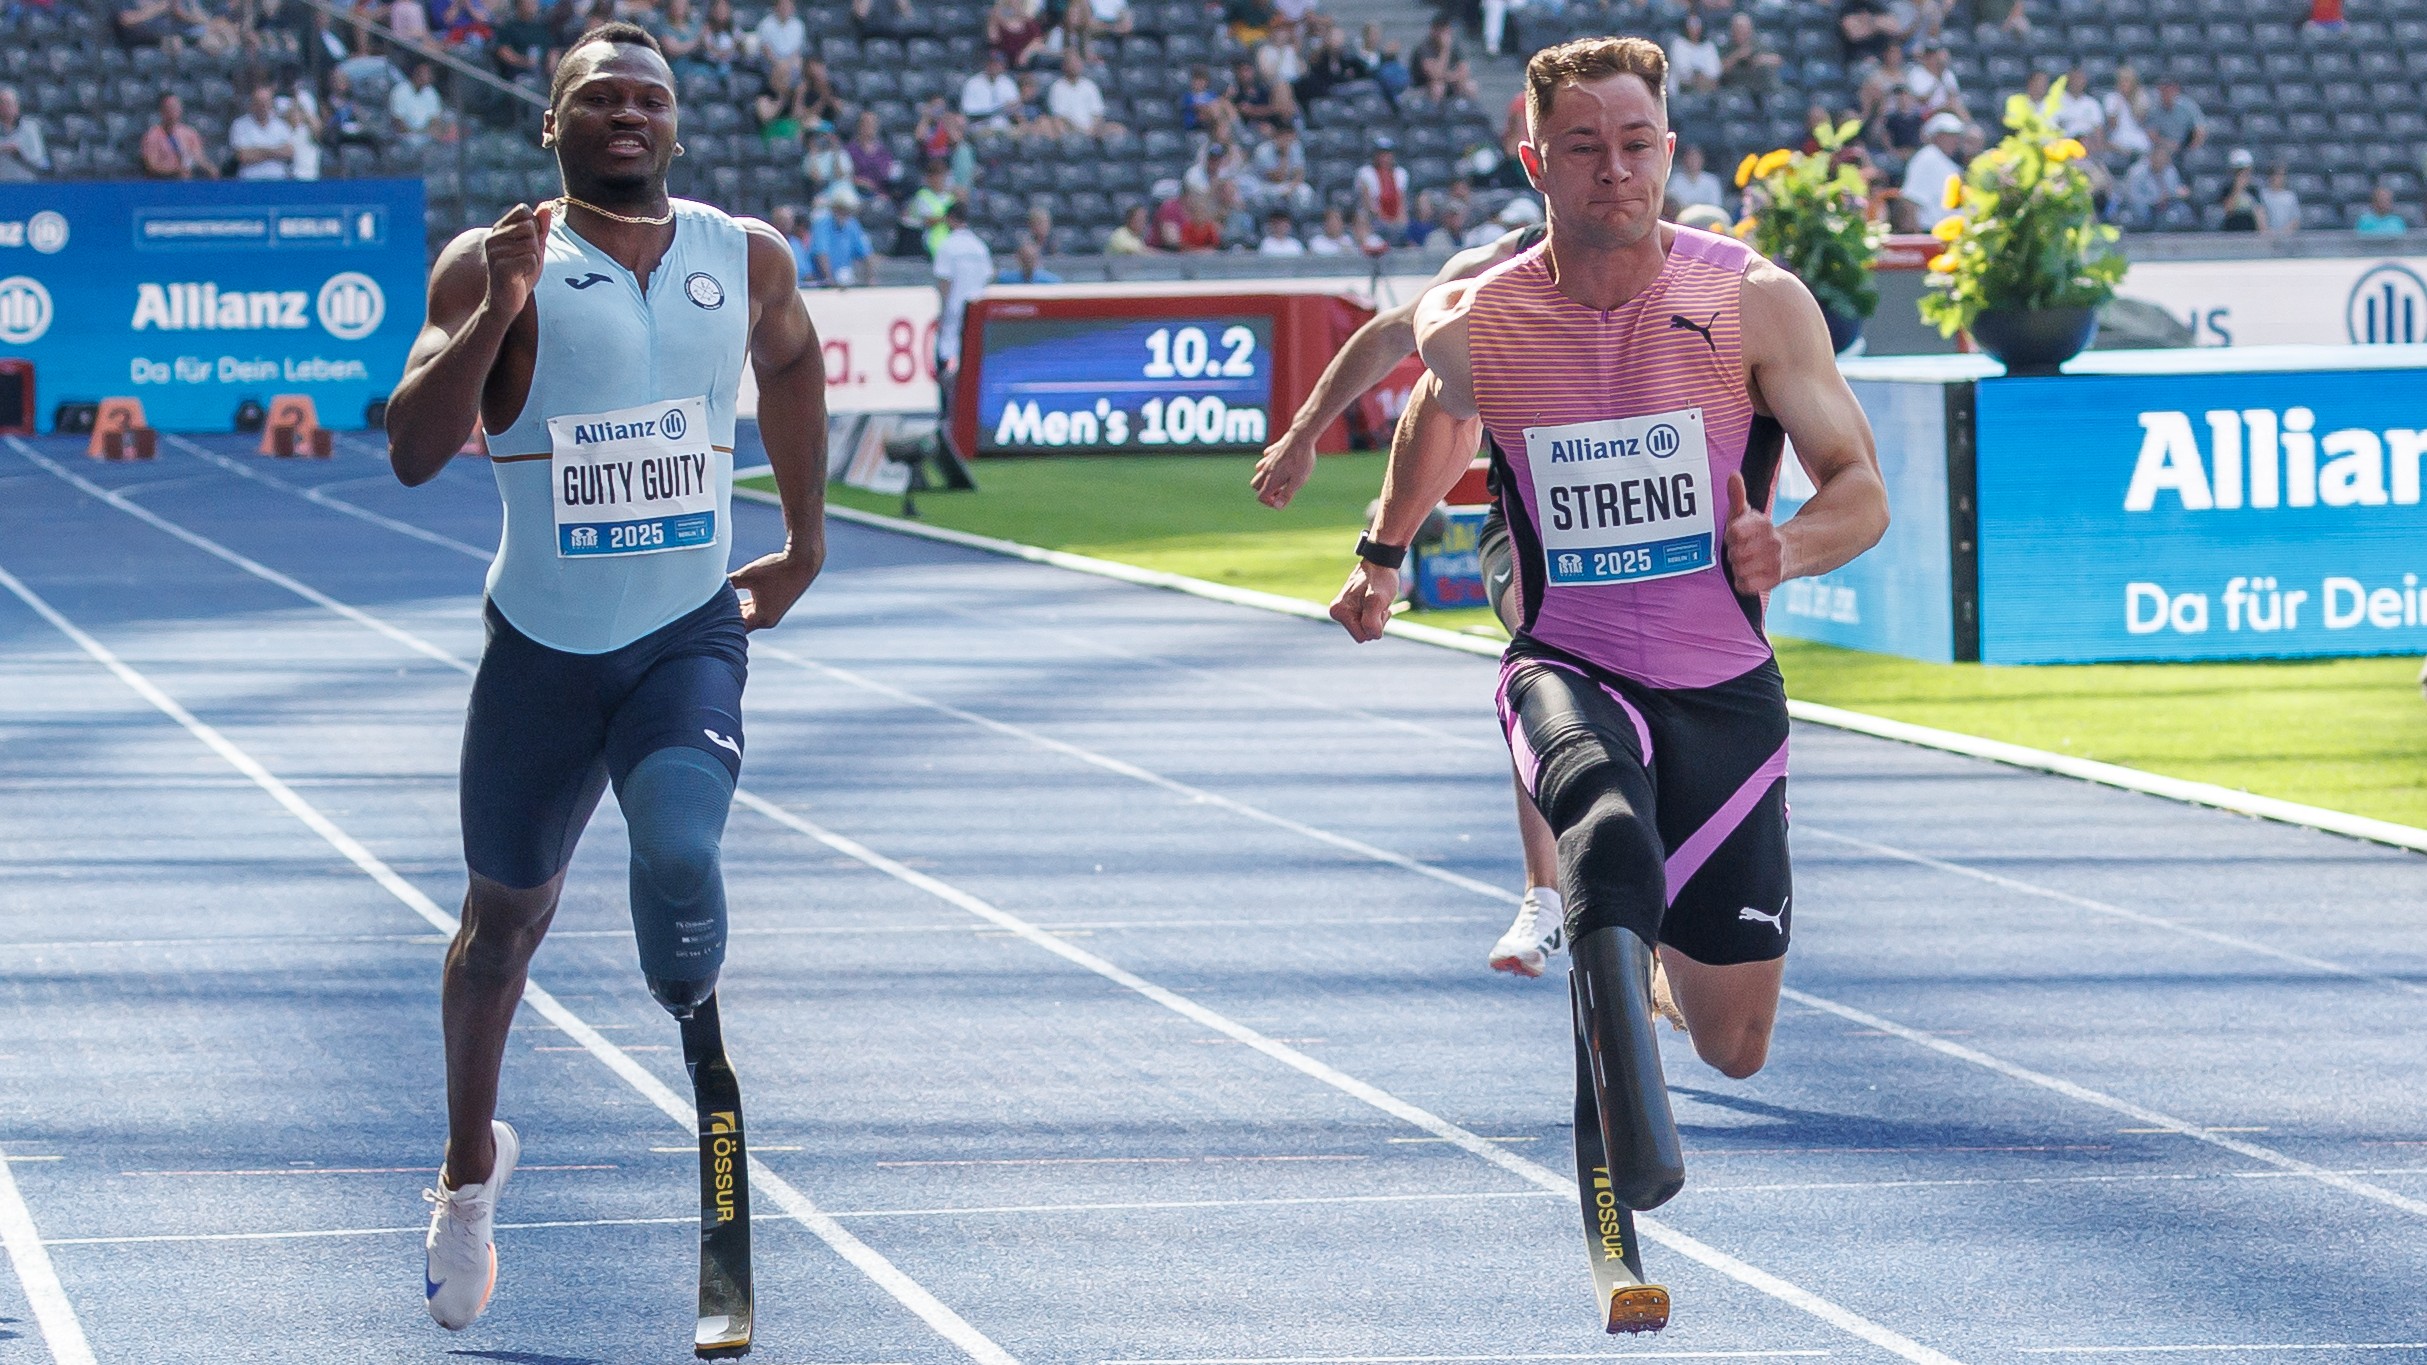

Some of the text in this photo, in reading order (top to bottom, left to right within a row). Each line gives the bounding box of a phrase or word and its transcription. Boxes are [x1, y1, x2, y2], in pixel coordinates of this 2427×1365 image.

[132, 282, 309, 330] Allianz
[131, 357, 170, 385] Da
[175, 355, 212, 383] für
[218, 354, 278, 383] Dein
[1143, 325, 1256, 378] 10.2
[575, 420, 656, 445] Allianz
[994, 395, 1267, 446] Men's 100m
[1551, 437, 1640, 463] Allianz
[563, 452, 706, 506] GUITY GUITY
[1550, 472, 1697, 531] STRENG
[611, 522, 665, 548] 2025
[1594, 548, 1652, 576] 2025
[2125, 572, 2427, 635] Da für Dei
[713, 1137, 738, 1222] ÖSSUR
